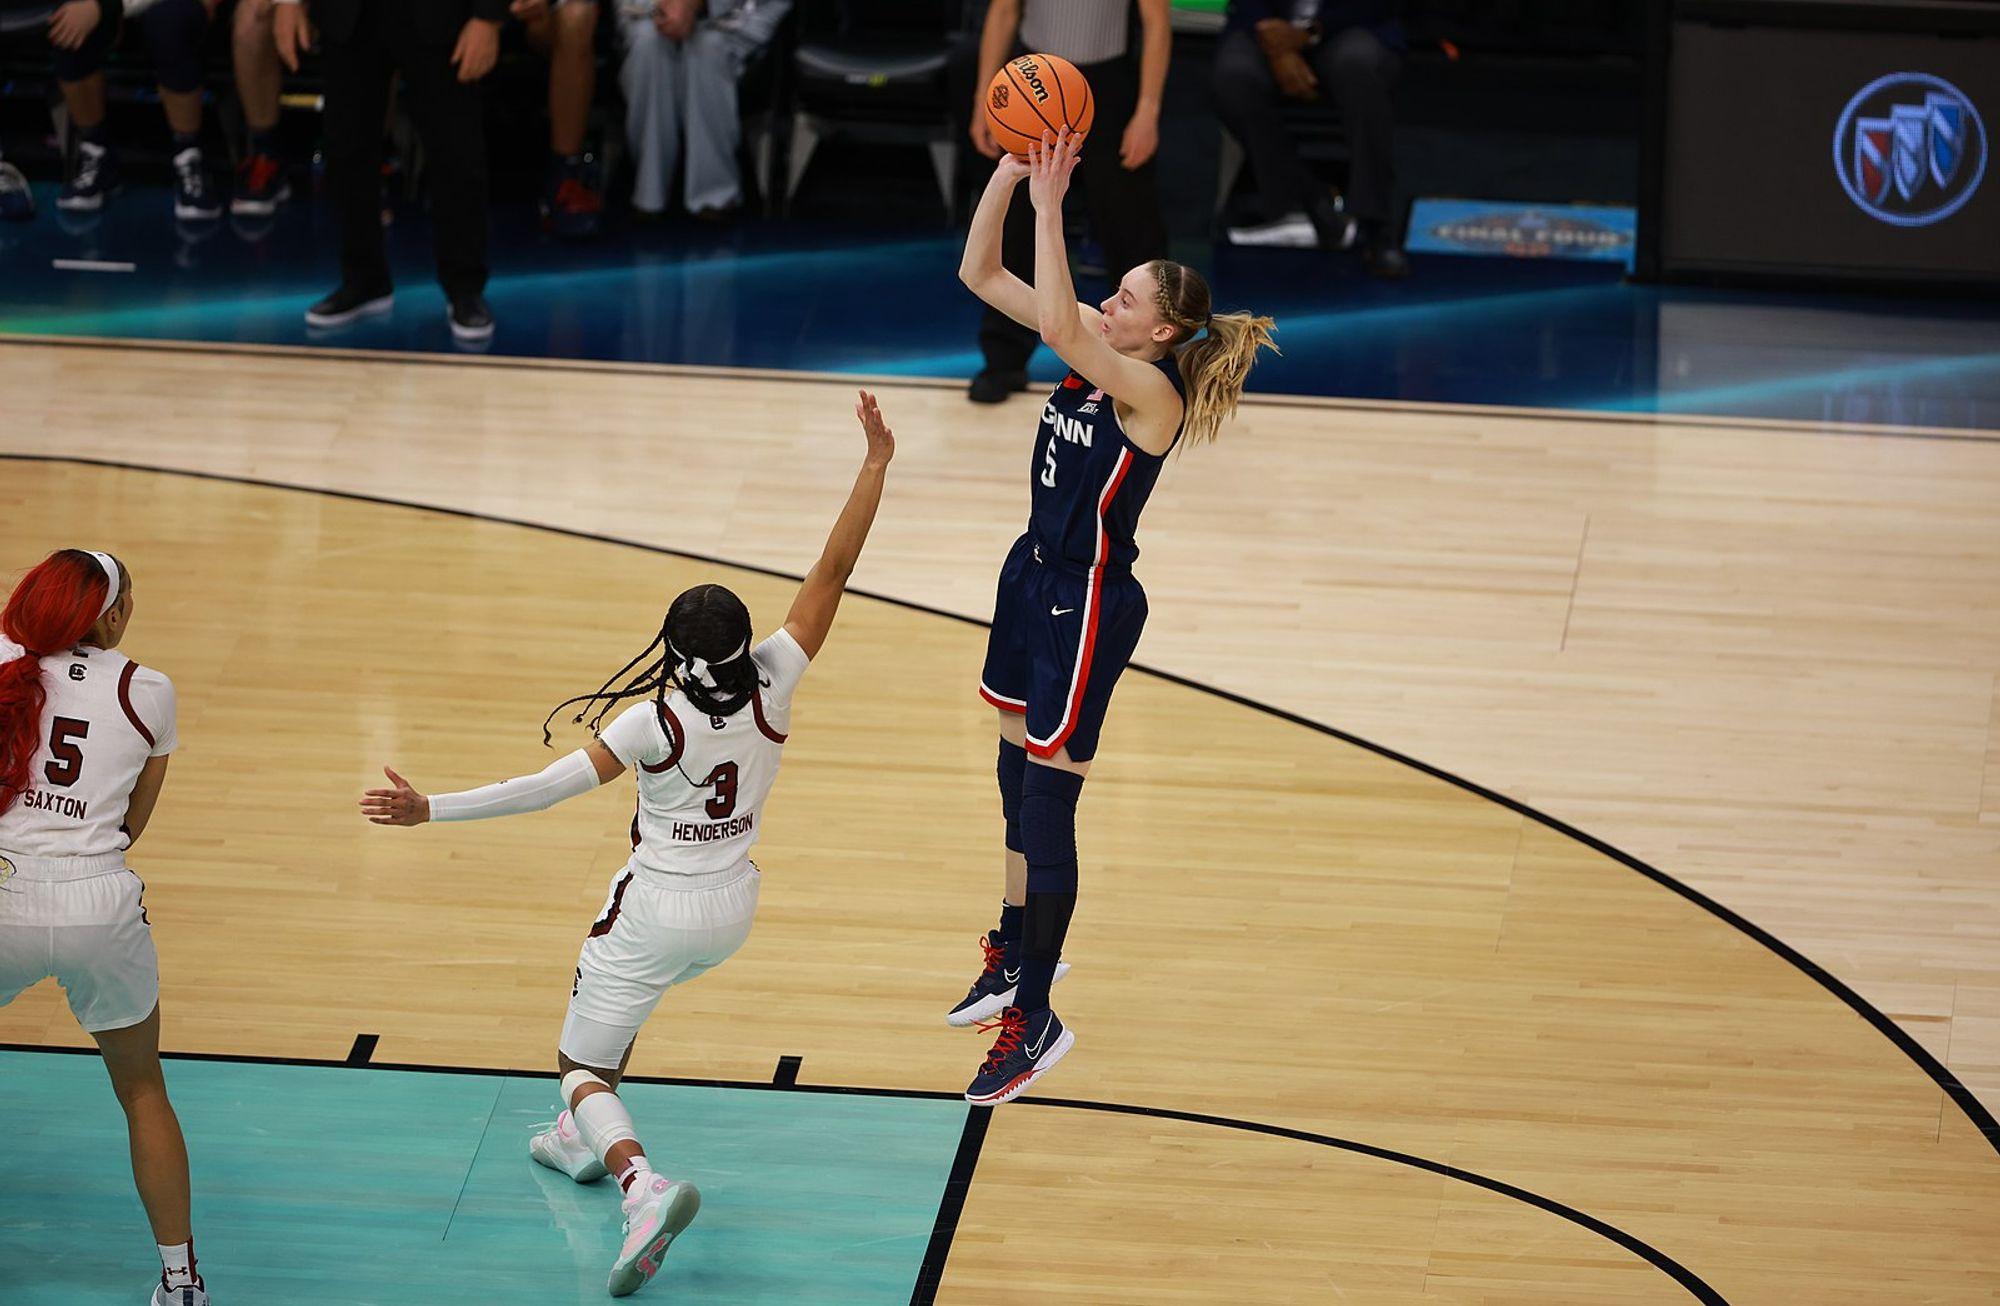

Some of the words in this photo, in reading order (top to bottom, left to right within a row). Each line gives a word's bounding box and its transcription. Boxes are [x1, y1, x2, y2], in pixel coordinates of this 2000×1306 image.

[1436, 225, 1522, 242] FINAL
[1535, 228, 1619, 247] FOUR
[44, 715, 90, 788] 5
[24, 788, 88, 820] SAXTON
[705, 760, 739, 820] 3
[671, 812, 754, 842] HENDERSON
